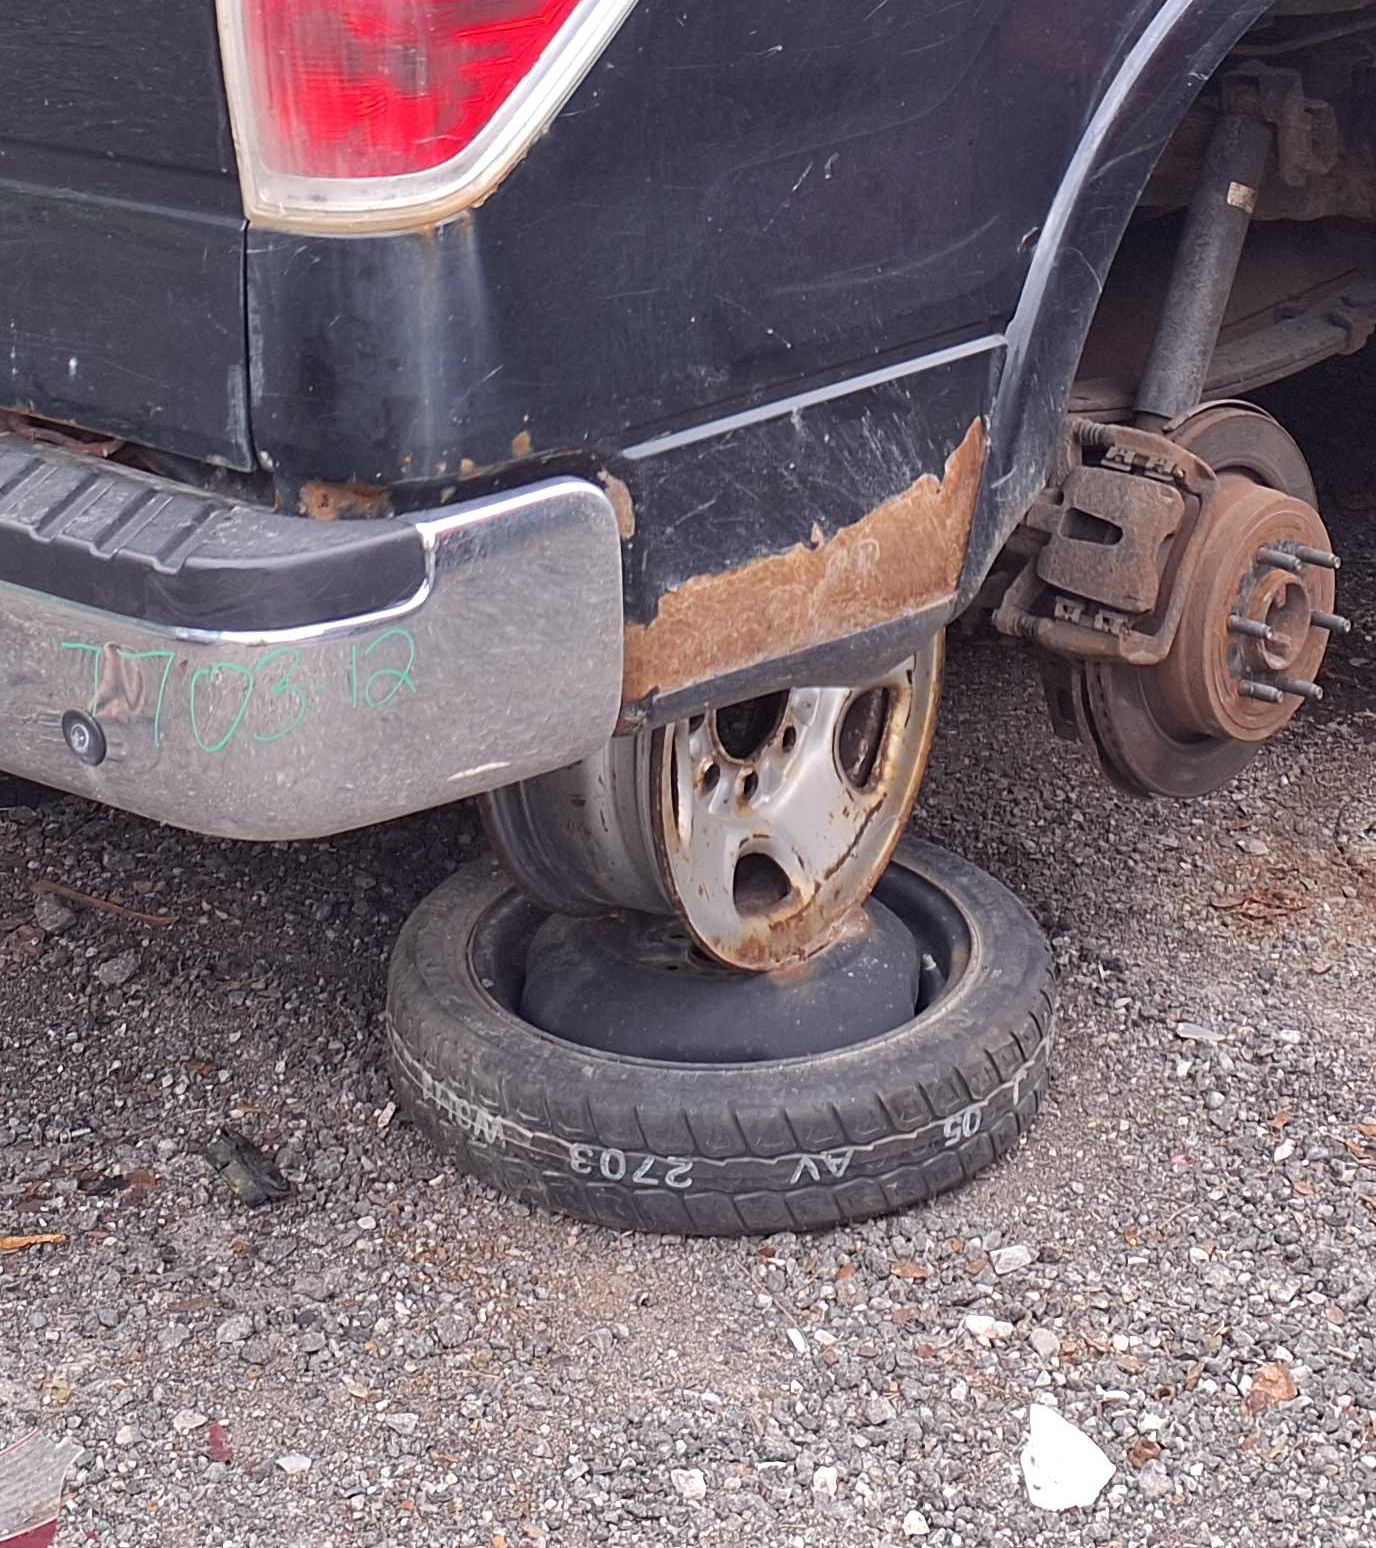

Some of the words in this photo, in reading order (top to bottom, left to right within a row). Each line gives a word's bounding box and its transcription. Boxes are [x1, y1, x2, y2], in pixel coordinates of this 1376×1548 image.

[61, 629, 416, 751] 7703-12
[943, 1105, 983, 1147] 05
[570, 1143, 694, 1189] 2703
[789, 1146, 855, 1185] AV
